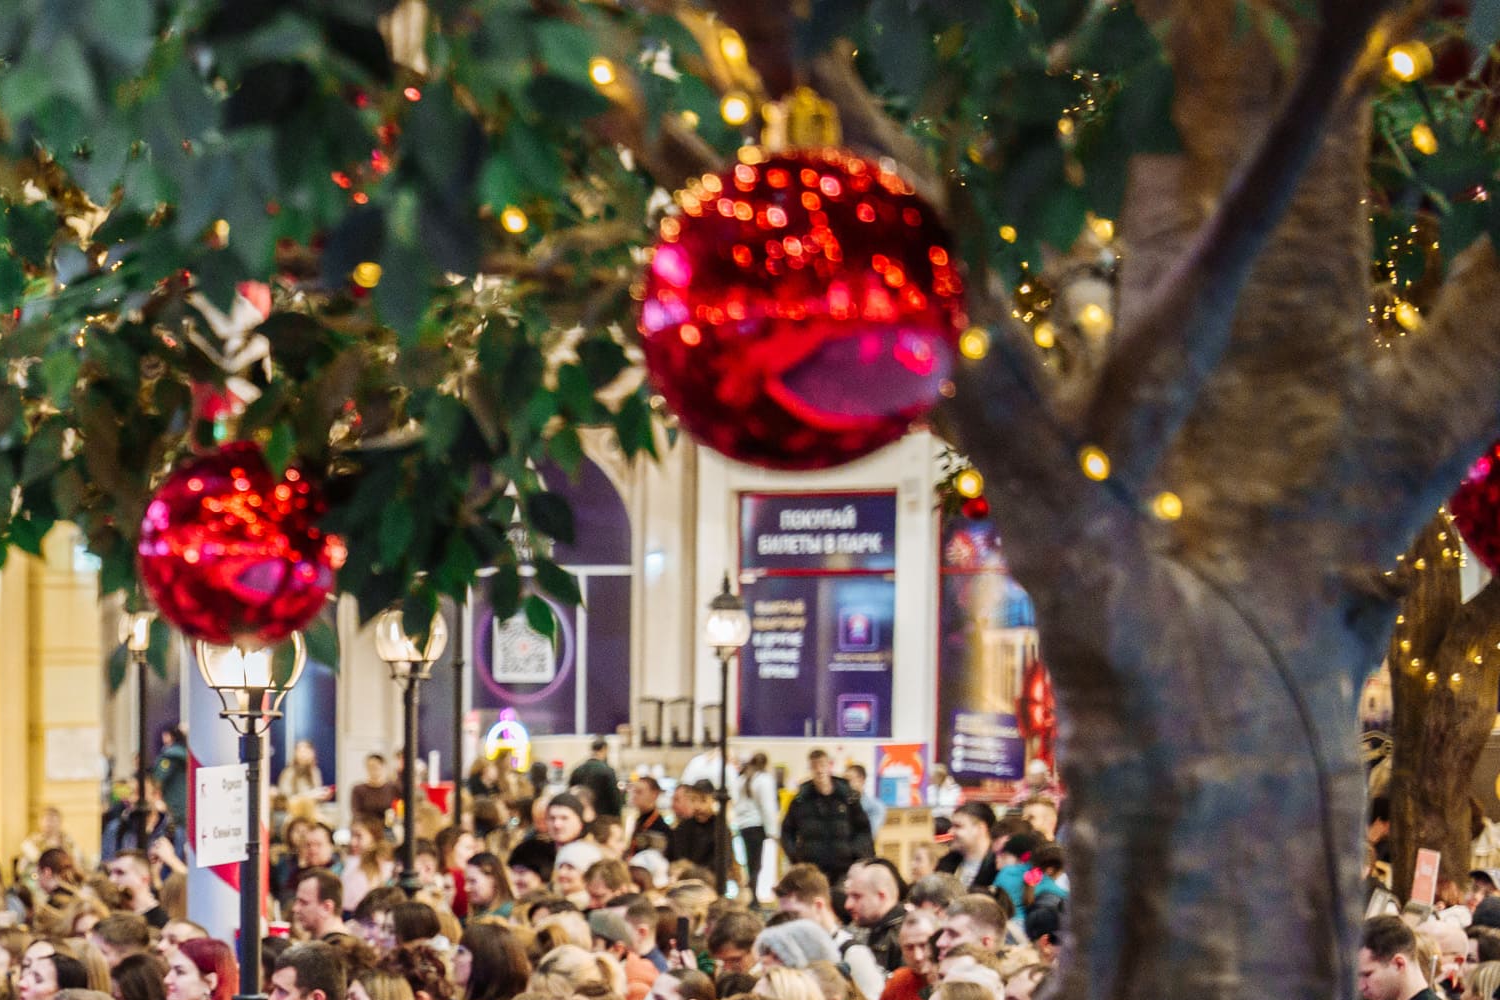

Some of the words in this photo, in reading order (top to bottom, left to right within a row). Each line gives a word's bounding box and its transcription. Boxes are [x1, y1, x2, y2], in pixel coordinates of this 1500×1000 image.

[780, 504, 857, 530] ПОКУПАЙ
[758, 534, 821, 555] БИЛЕТЫ
[824, 535, 836, 554] В
[837, 533, 882, 554] ПАРК
